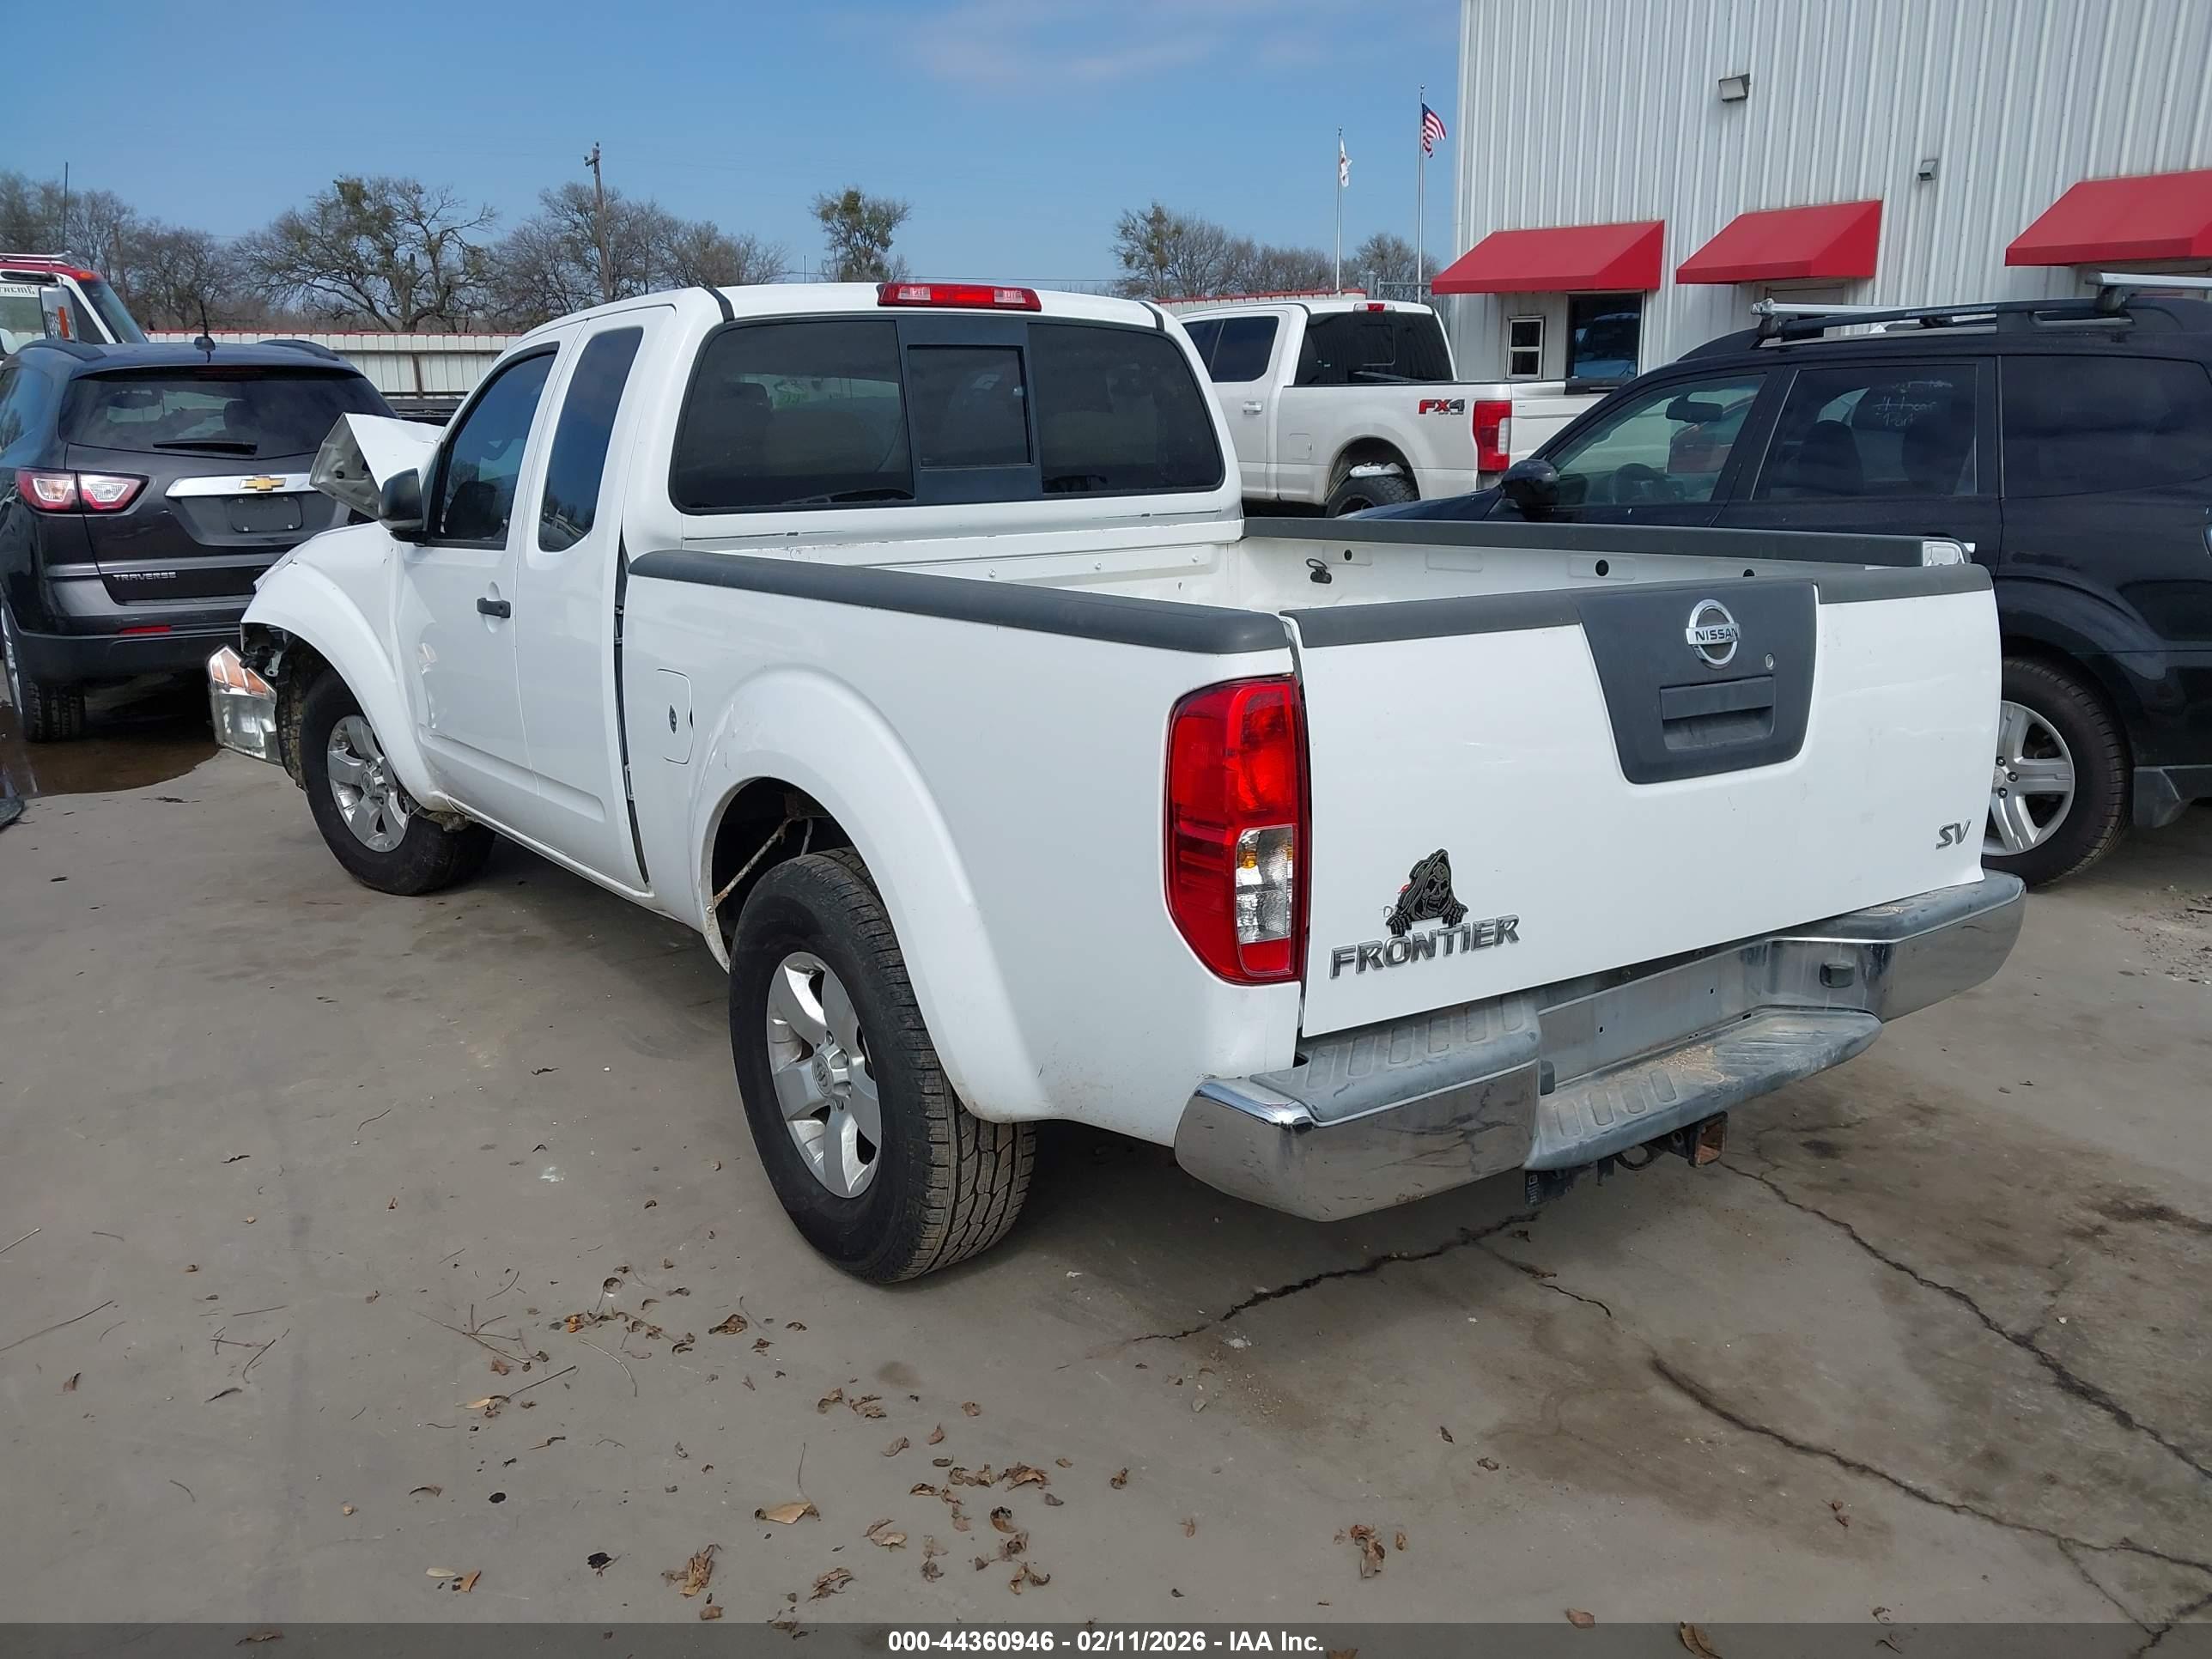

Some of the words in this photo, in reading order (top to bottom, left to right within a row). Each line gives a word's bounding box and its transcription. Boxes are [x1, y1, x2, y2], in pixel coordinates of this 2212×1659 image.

[1419, 398, 1465, 414] FX4
[112, 571, 177, 580] TRAVERSE
[1694, 627, 1738, 641] NISSAN
[1936, 818, 1972, 849] SV
[1329, 914, 1520, 980] FRONTIER
